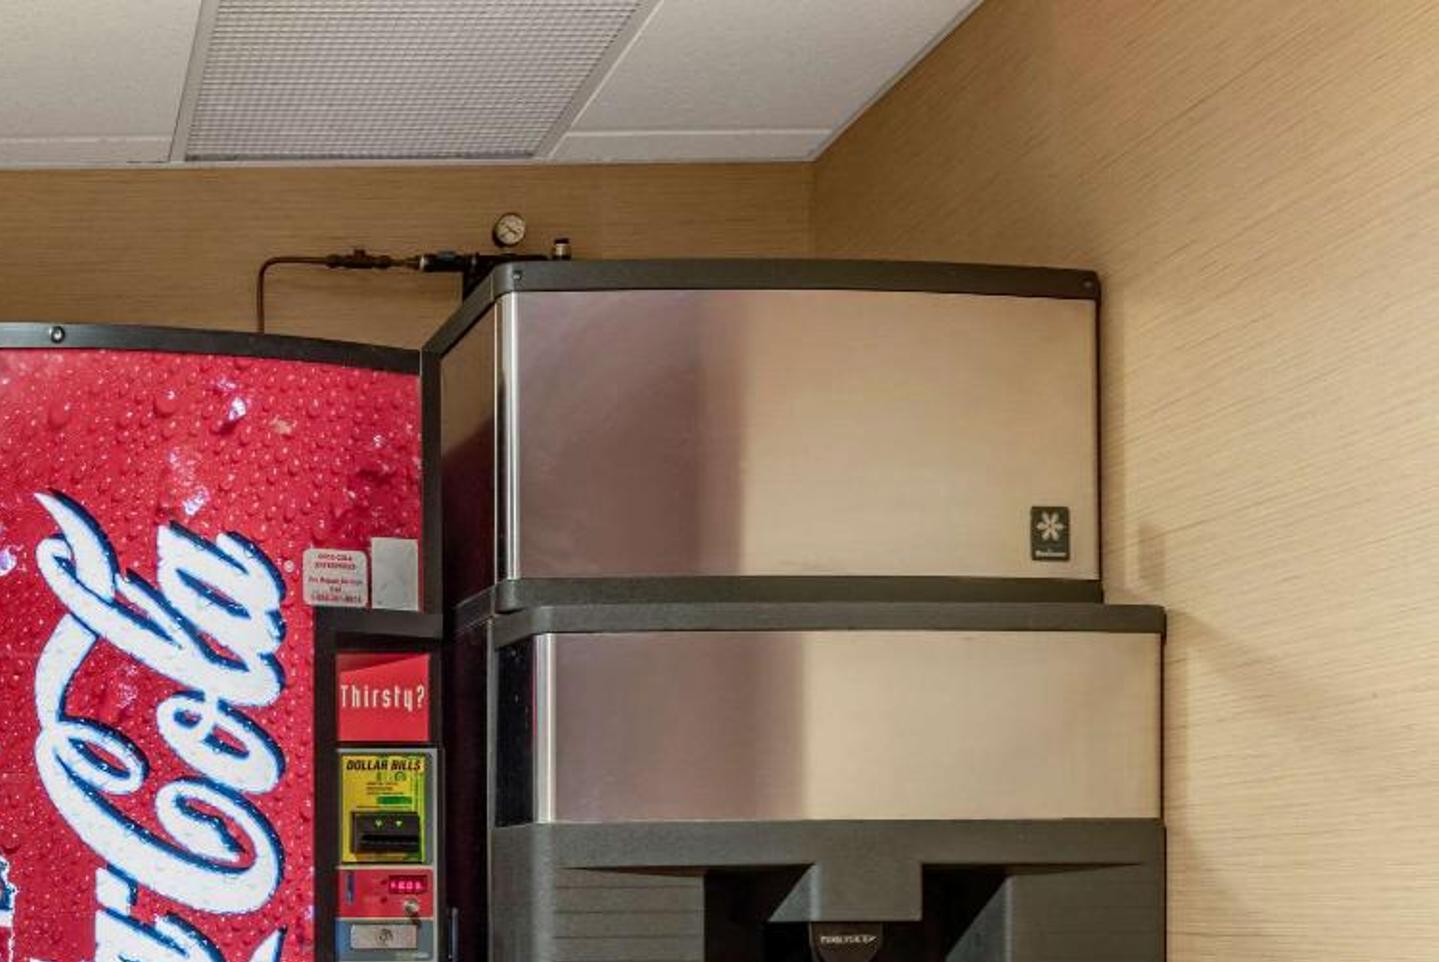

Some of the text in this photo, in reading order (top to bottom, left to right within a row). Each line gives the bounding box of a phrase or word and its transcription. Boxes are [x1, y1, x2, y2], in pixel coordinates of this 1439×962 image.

[340, 684, 425, 712] Thirsty?
[346, 759, 421, 771] DOLLAR BILLS
